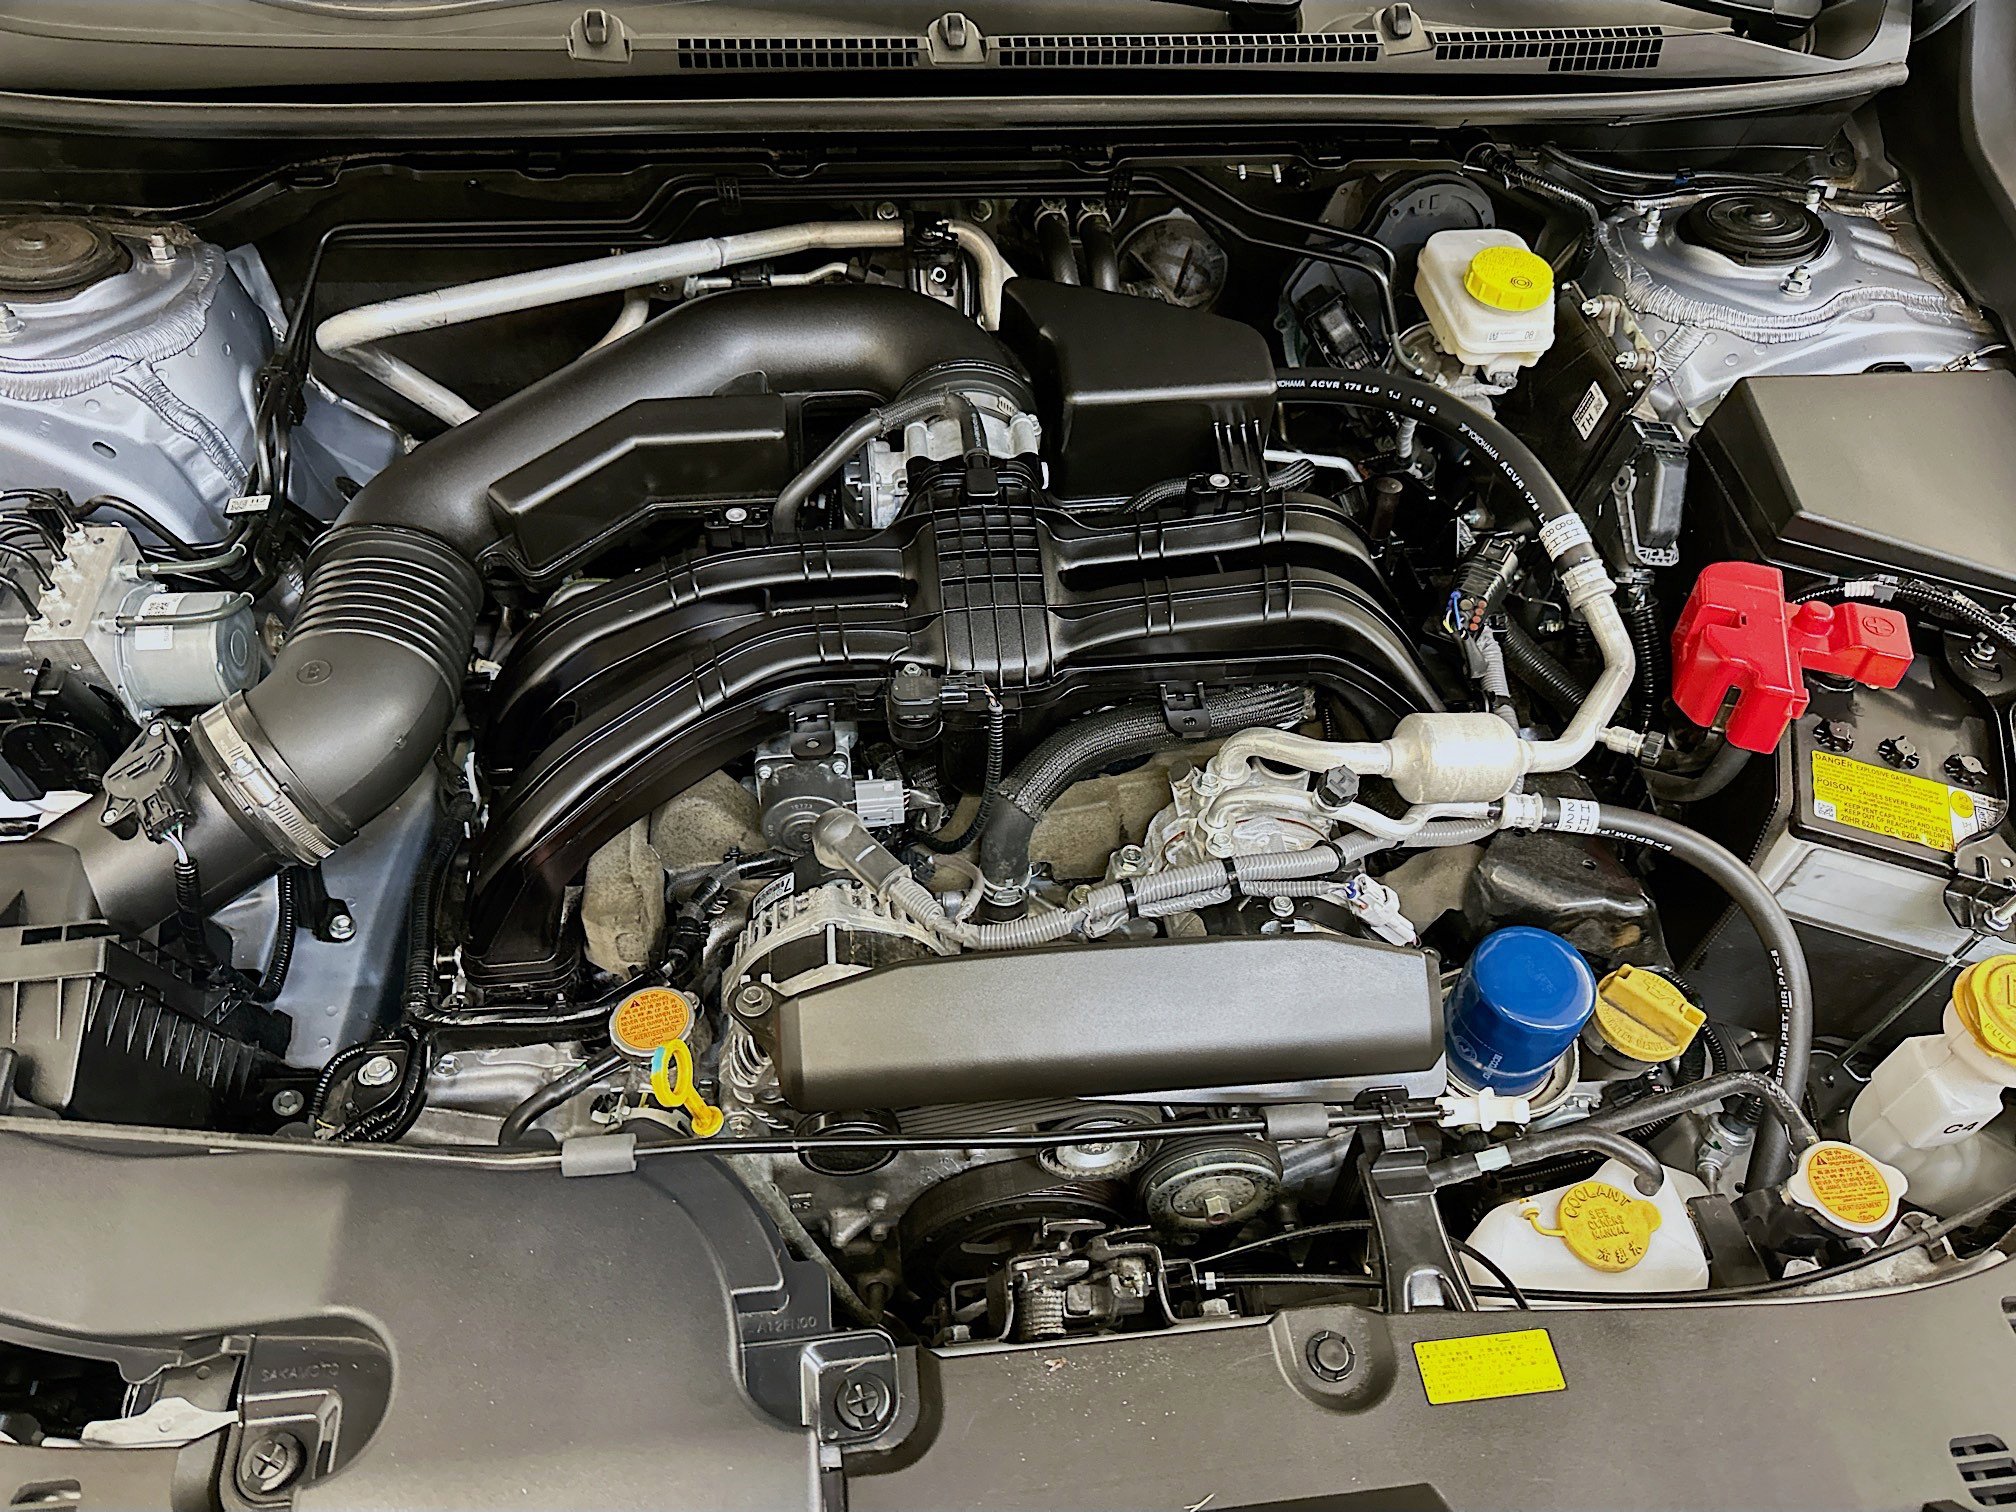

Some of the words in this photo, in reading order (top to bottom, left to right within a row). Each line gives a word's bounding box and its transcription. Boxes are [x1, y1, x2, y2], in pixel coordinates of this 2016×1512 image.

[1467, 429, 1500, 460] YOKOHAMA
[1815, 753, 1853, 769] DANGER
[1856, 765, 1890, 779] EXPLOSIVE
[1890, 774, 1912, 785] GASES
[1816, 776, 1853, 793] POISON
[1858, 789, 1884, 801] CAUSES
[1884, 795, 1909, 807] SEVERE
[1910, 802, 1932, 813] BURNS
[1840, 814, 1860, 825] 20HR
[1844, 802, 1861, 810] KEEP
[1862, 806, 1878, 815] VENT
[1879, 811, 1896, 820] CAPS
[1898, 816, 1916, 825] TIGHT
[1917, 822, 1931, 830] AND
[1931, 826, 1951, 836] LEVEL
[1844, 808, 1861, 816] KEEP
[1862, 812, 1875, 821] OUT
[1886, 819, 1908, 830] REACH
[621, 1017, 638, 1026] NEVER
[640, 1014, 654, 1023] OPEN
[654, 1011, 671, 1019] WHEN
[672, 1007, 684, 1015] HOT
[1943, 1120, 1979, 1134] C4
[1564, 1185, 1632, 1218] COOLANT
[1588, 1207, 1609, 1220] SEE
[1592, 1225, 1629, 1240] MANUAL
